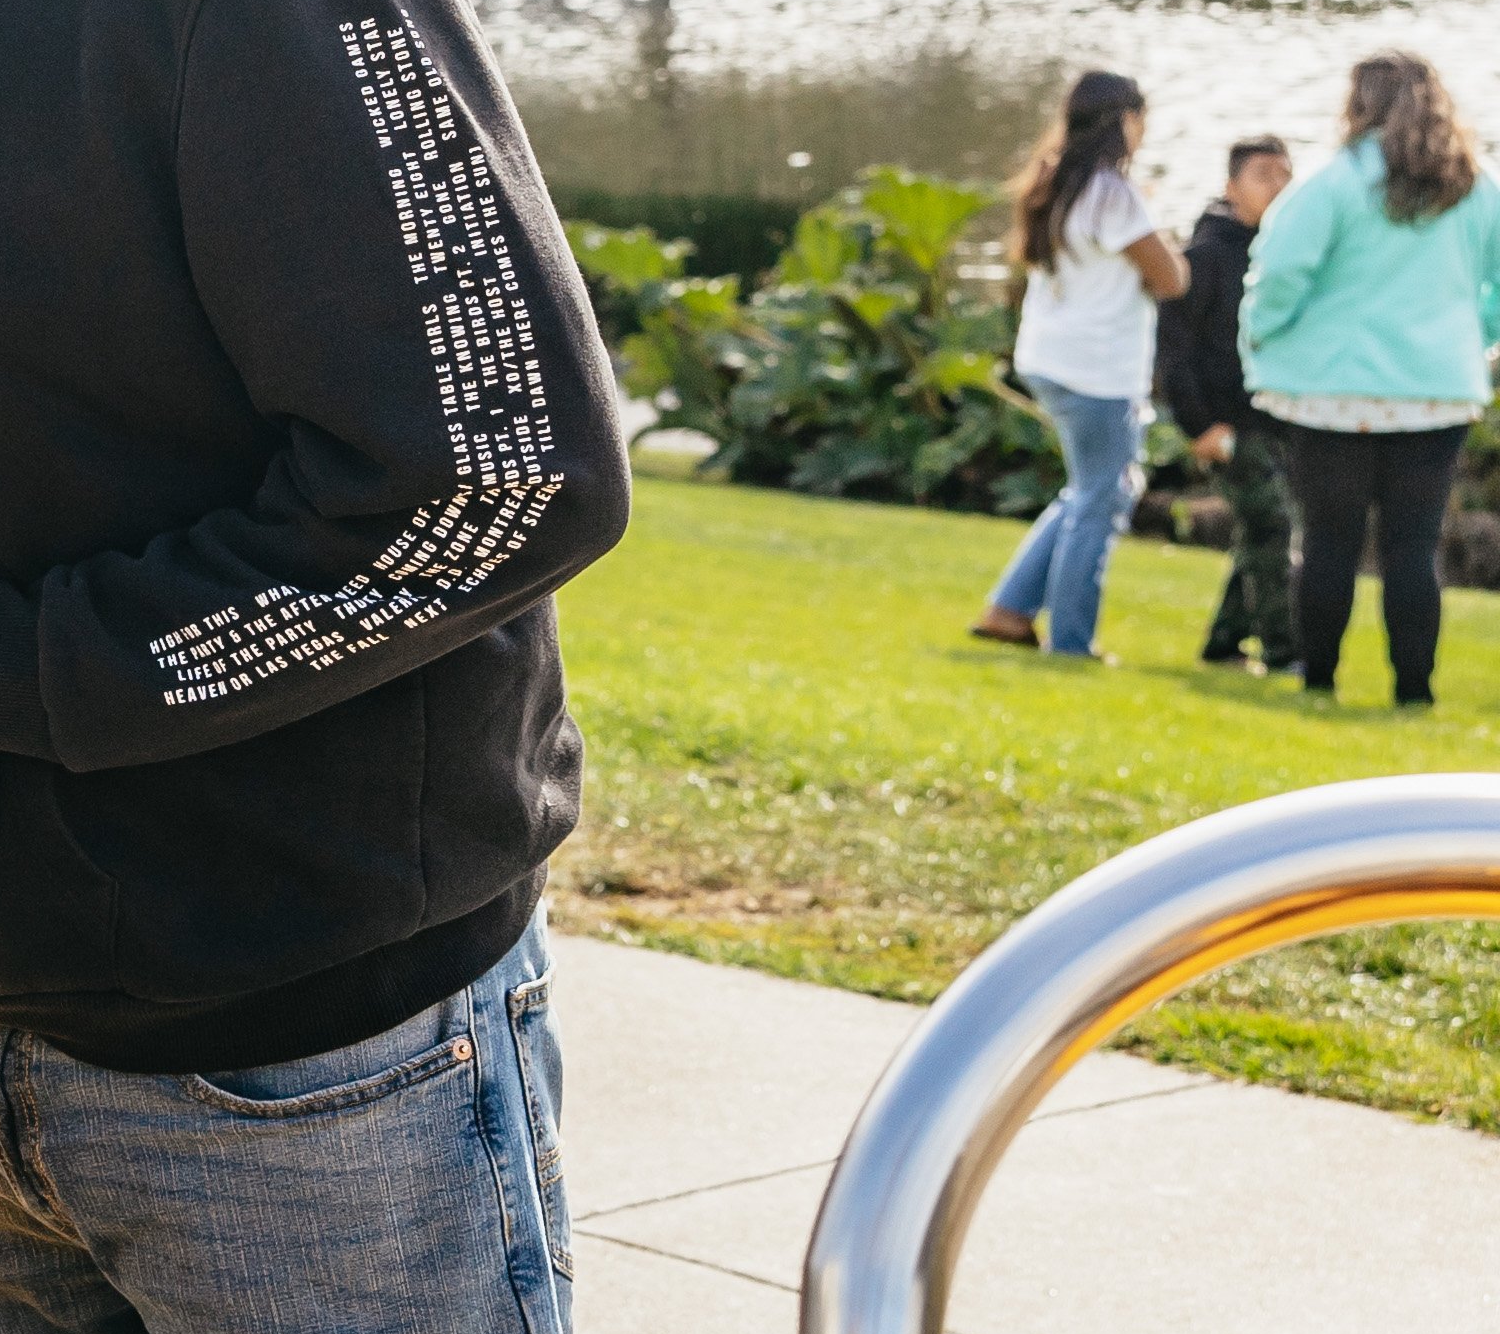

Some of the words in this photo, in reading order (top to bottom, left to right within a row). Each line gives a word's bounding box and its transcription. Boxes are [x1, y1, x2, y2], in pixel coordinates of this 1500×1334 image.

[339, 21, 369, 79] GAMES
[360, 17, 386, 62] STAR
[387, 27, 416, 82] STONE
[420, 57, 442, 87] OLD
[361, 85, 393, 149] WICKED
[375, 70, 407, 131] LONELY
[406, 88, 438, 161] ROLLING
[432, 94, 457, 141] SAME
[403, 151, 428, 200] EIGHT
[389, 168, 418, 245] MORNING
[432, 181, 457, 224] GONE
[449, 161, 487, 257] INITIATION
[479, 195, 500, 228] THE
[408, 252, 429, 284] THE
[419, 209, 448, 274] TWENTY
[452, 245, 466, 254] 2
[490, 235, 519, 291] COMES
[457, 261, 475, 288] PT.
[483, 277, 506, 320] HOST
[422, 303, 446, 356] GIRLS
[443, 293, 474, 373] KNOWING
[465, 295, 491, 347] BIRDS
[480, 354, 499, 387] THE
[496, 326, 522, 394] XO/THE
[525, 359, 547, 408] DAWN
[435, 363, 459, 416] TABLE
[462, 380, 481, 412] THE
[448, 422, 472, 476] GLASS
[473, 433, 498, 486] MUSIC
[494, 426, 513, 452] PT.
[513, 415, 543, 485] OUTSIDE
[535, 415, 555, 452] TILL
[149, 630, 183, 655] HIGH
[203, 606, 240, 630] THIS
[372, 530, 417, 570] HOUSE
[412, 508, 431, 528] OF
[157, 650, 188, 669] THE
[189, 635, 225, 661] PARTY
[229, 629, 241, 644] &
[243, 613, 277, 636] THE
[388, 540, 437, 581] COMING
[432, 492, 468, 539] DOWN
[164, 680, 228, 706] HEAVEN
[229, 672, 253, 691] OR
[255, 655, 288, 678] LAS
[290, 631, 345, 661] VEGAS
[473, 484, 532, 558] MONTREAL
[177, 663, 213, 682] LIFE
[212, 658, 227, 674] OF
[229, 643, 263, 666] THE
[265, 620, 316, 651] PARTY
[443, 521, 479, 561] ZONE
[480, 487, 501, 505] TH
[309, 649, 344, 671] THE
[346, 632, 390, 654] FALL
[403, 597, 448, 629] NEXT
[458, 553, 510, 593] ECHOES
[507, 530, 527, 550] OF
[522, 472, 564, 527] SILENCE
